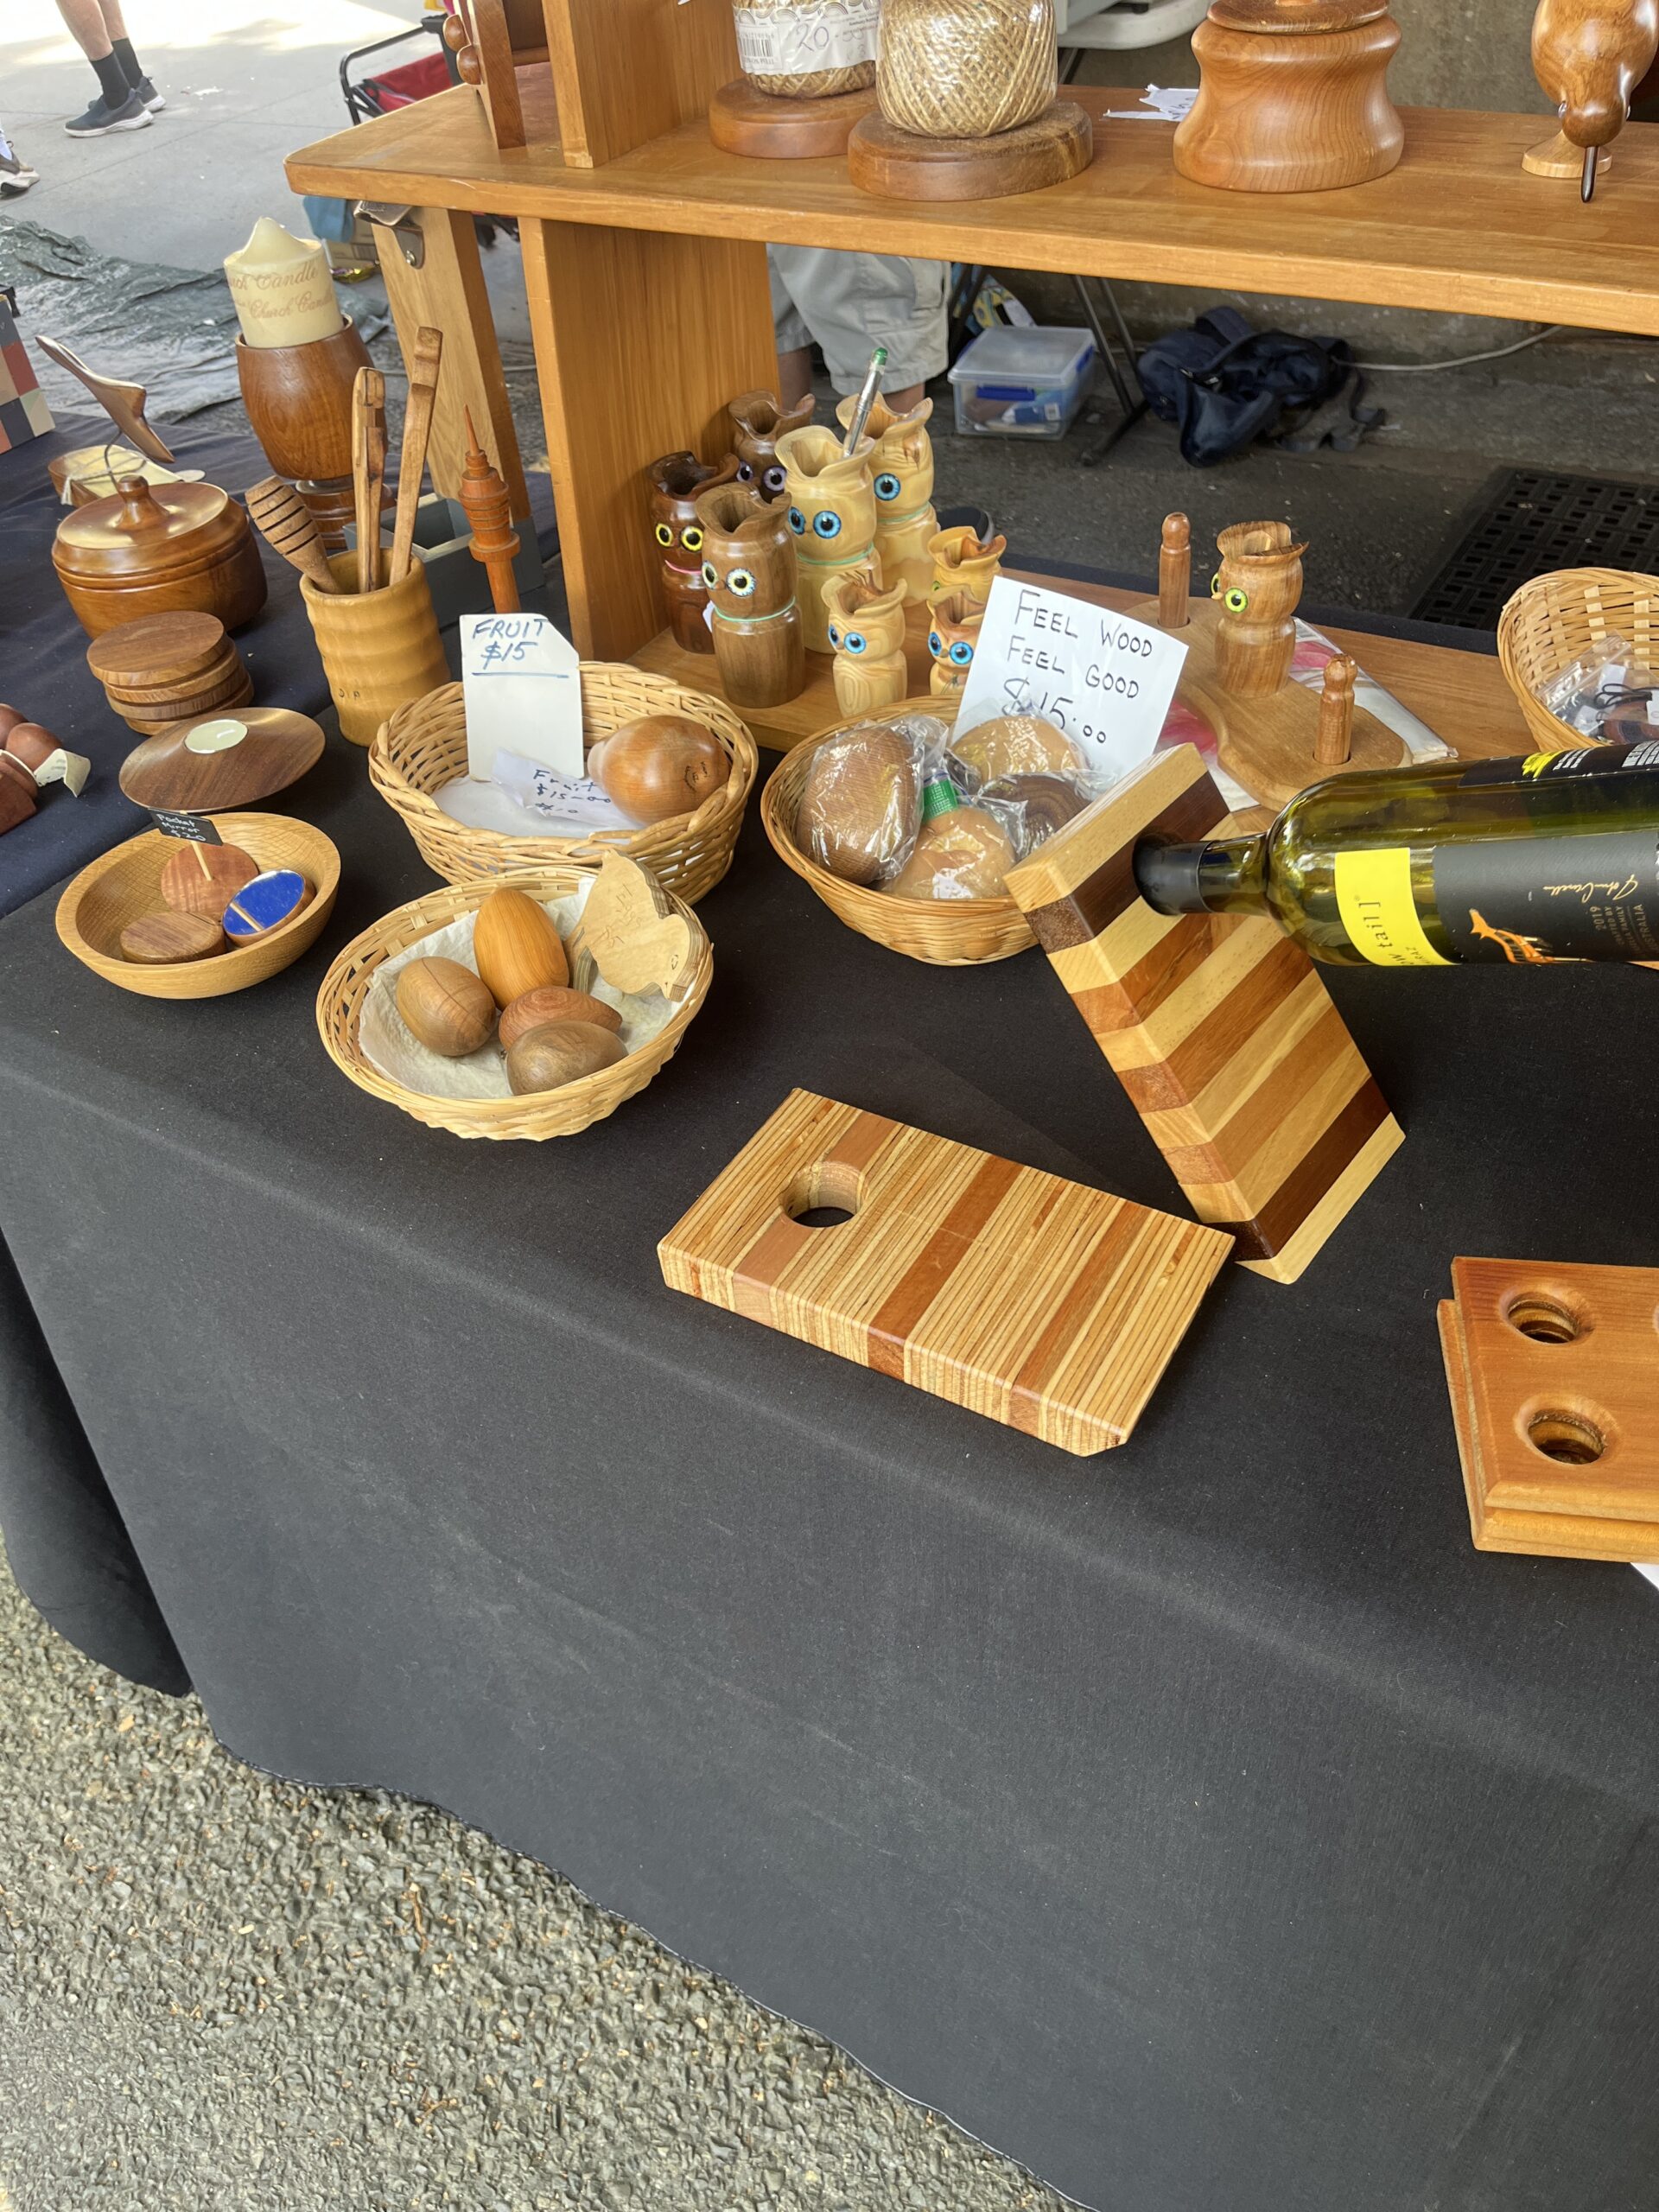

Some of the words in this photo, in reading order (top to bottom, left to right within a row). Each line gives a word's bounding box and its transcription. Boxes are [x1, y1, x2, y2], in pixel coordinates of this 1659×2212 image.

[473, 618, 549, 639] FRUIT
[1014, 589, 1078, 639] FEEL
[1101, 619, 1153, 657] WOOD
[480, 640, 538, 670] $15
[1007, 635, 1065, 674] FEEL
[1085, 664, 1139, 698] GOOD
[1590, 906, 1607, 931] 2019
[1604, 906, 1613, 916] BY
[1615, 906, 1630, 931] FAMILY
